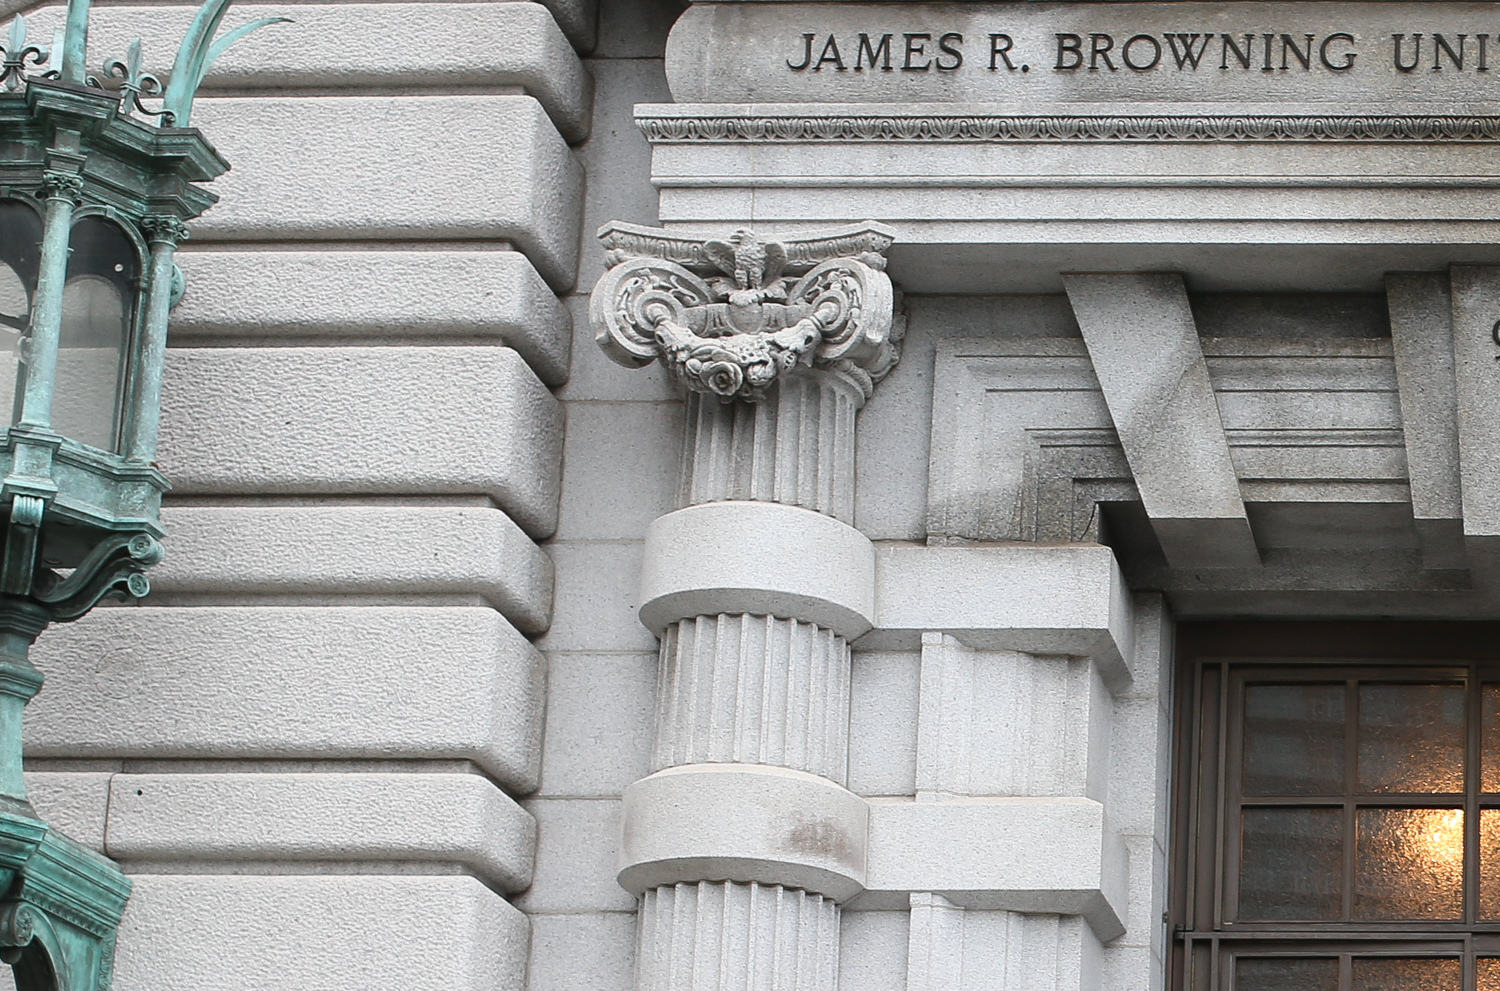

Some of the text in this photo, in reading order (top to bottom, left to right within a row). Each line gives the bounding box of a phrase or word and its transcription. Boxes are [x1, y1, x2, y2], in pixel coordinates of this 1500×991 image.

[786, 32, 965, 72] JAMES
[987, 33, 1030, 73] R.
[1053, 32, 1357, 72] BROWNING
